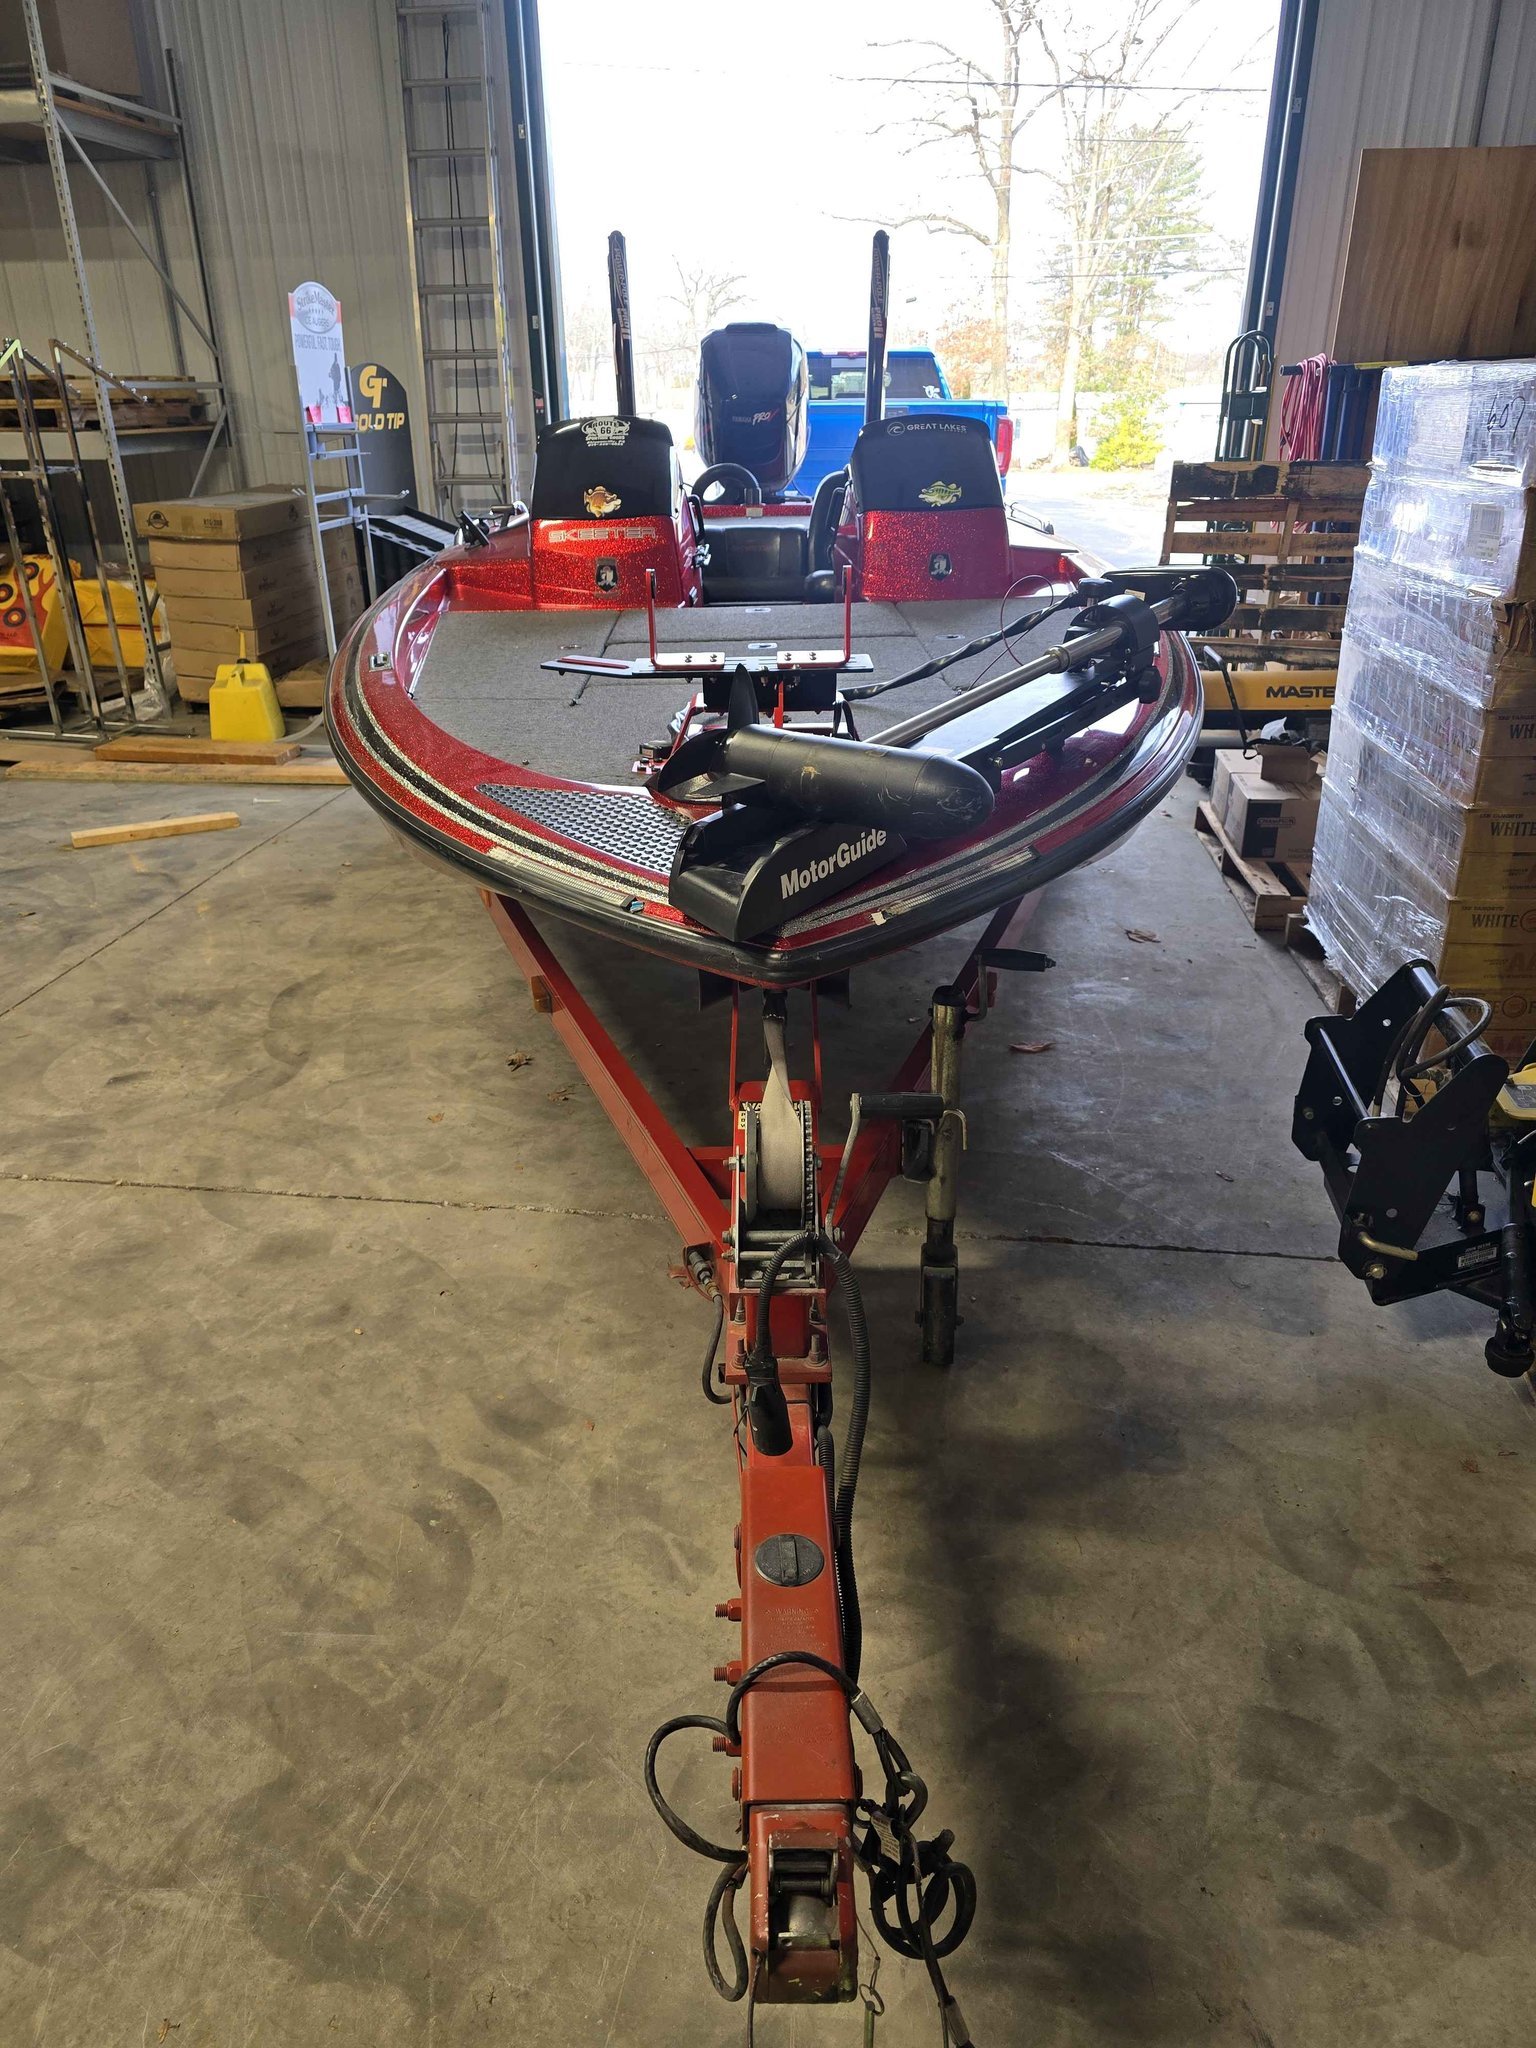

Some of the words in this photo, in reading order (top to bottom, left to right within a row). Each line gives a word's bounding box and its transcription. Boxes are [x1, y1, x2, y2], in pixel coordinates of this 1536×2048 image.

[297, 291, 334, 316] StrikeMaster
[387, 412, 405, 429] TIP
[592, 420, 618, 428] ROUTE
[906, 423, 937, 431] GREAT
[549, 527, 656, 543] SKEETER
[781, 828, 887, 900] MotorGuide
[1472, 914, 1519, 928] WHITE
